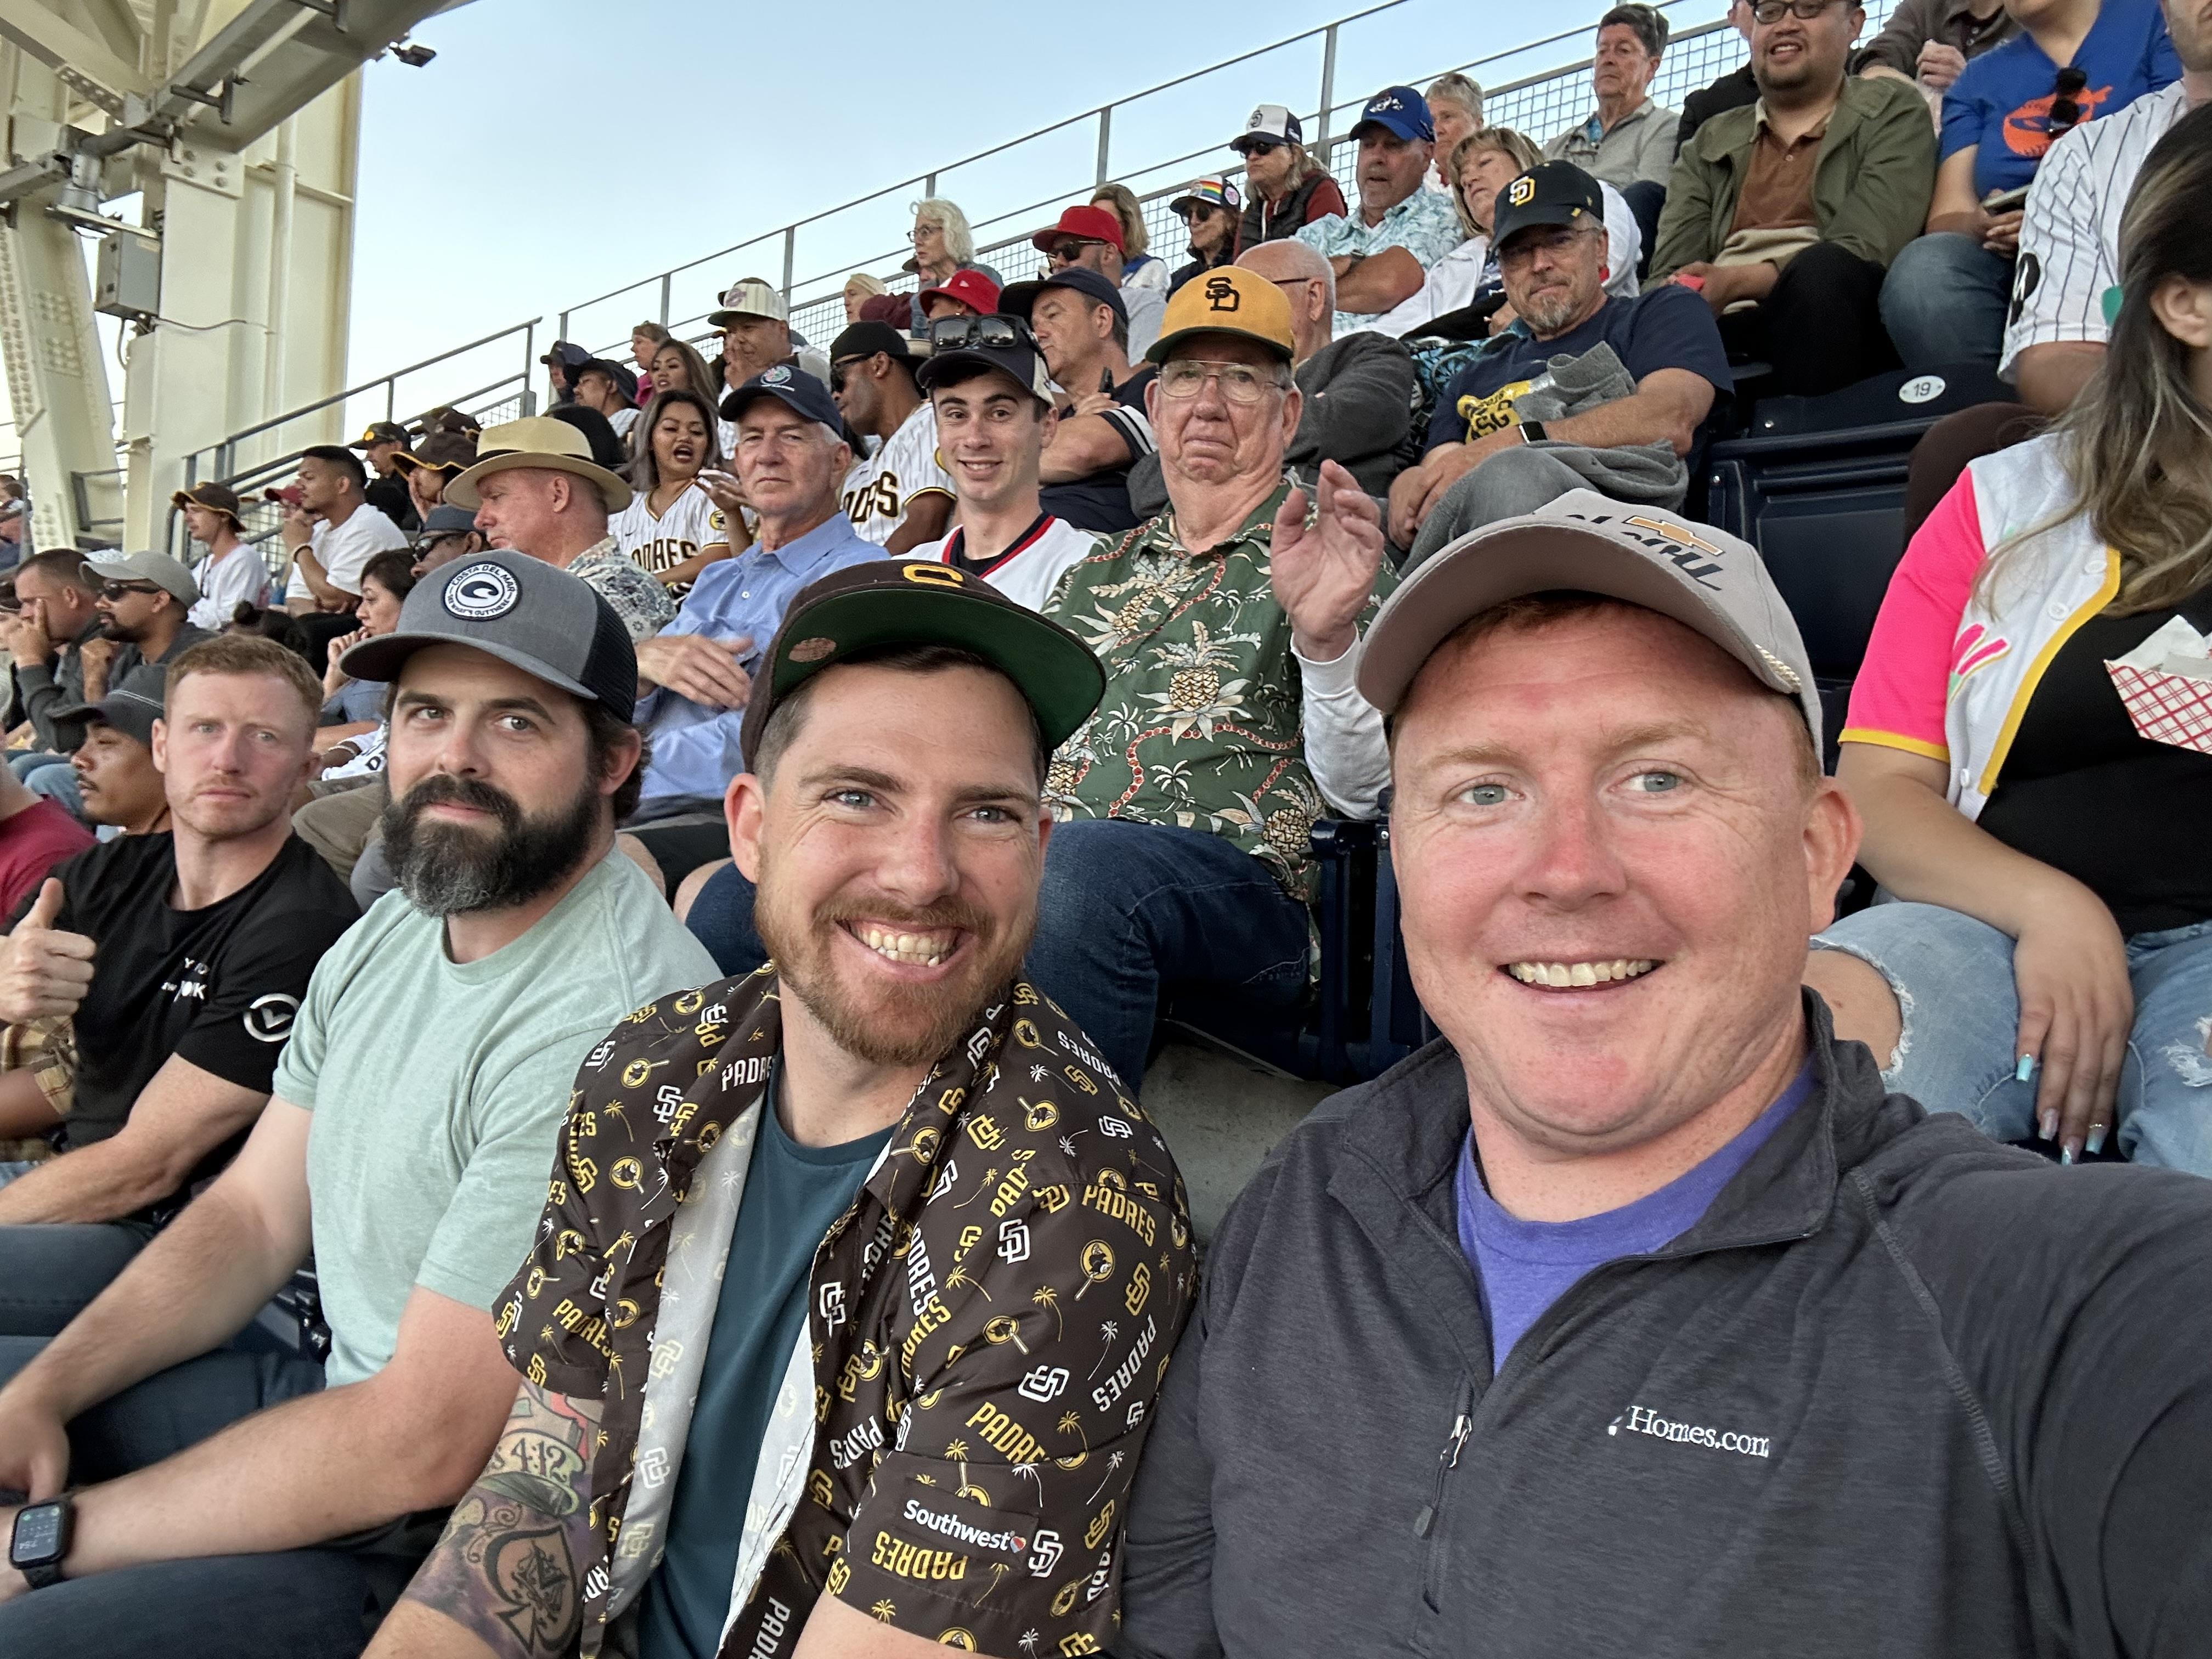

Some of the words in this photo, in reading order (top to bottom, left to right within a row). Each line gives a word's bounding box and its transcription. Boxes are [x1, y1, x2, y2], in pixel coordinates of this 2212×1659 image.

[1509, 176, 1536, 206] SD
[1205, 276, 1240, 312] SD
[1914, 382, 1931, 397] 19
[451, 566, 479, 586] COSTA
[482, 565, 500, 575] DEL
[500, 574, 516, 592] MAR
[653, 1085, 684, 1124] SD
[1081, 1184, 1155, 1248] PADRES
[997, 1218, 1030, 1265] SD
[1125, 1262, 1150, 1316] SD
[1018, 1365, 1070, 1403] SD
[1092, 1314, 1156, 1412] PADRES
[1626, 1405, 1770, 1458] Homes.com
[904, 1499, 1011, 1551] Southwest
[871, 1531, 969, 1581] PADRES
[1028, 1530, 1064, 1578] SD
